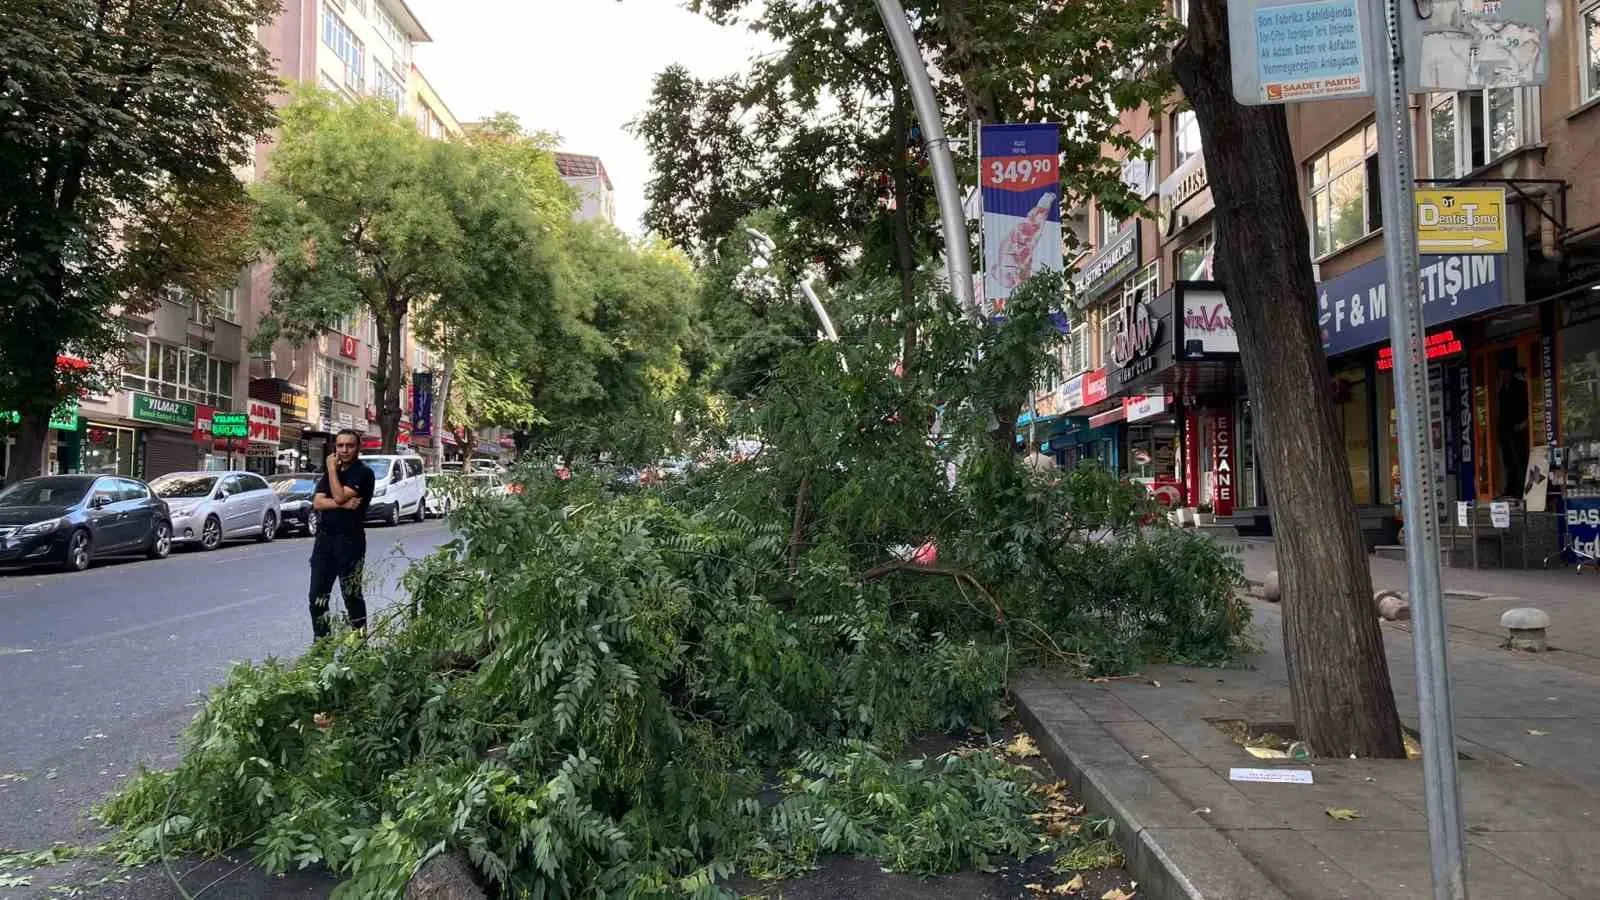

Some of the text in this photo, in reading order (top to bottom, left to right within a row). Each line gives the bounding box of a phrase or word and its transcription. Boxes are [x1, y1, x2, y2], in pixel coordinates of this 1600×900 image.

[1282, 81, 1321, 91] SAADET
[1335, 300, 1345, 333] F
[1350, 293, 1365, 327] &
[1369, 283, 1387, 321] M
[149, 399, 179, 414] YILMAZ
[1218, 417, 1231, 501] ECZANE
[1567, 509, 1600, 528] BAŞ
